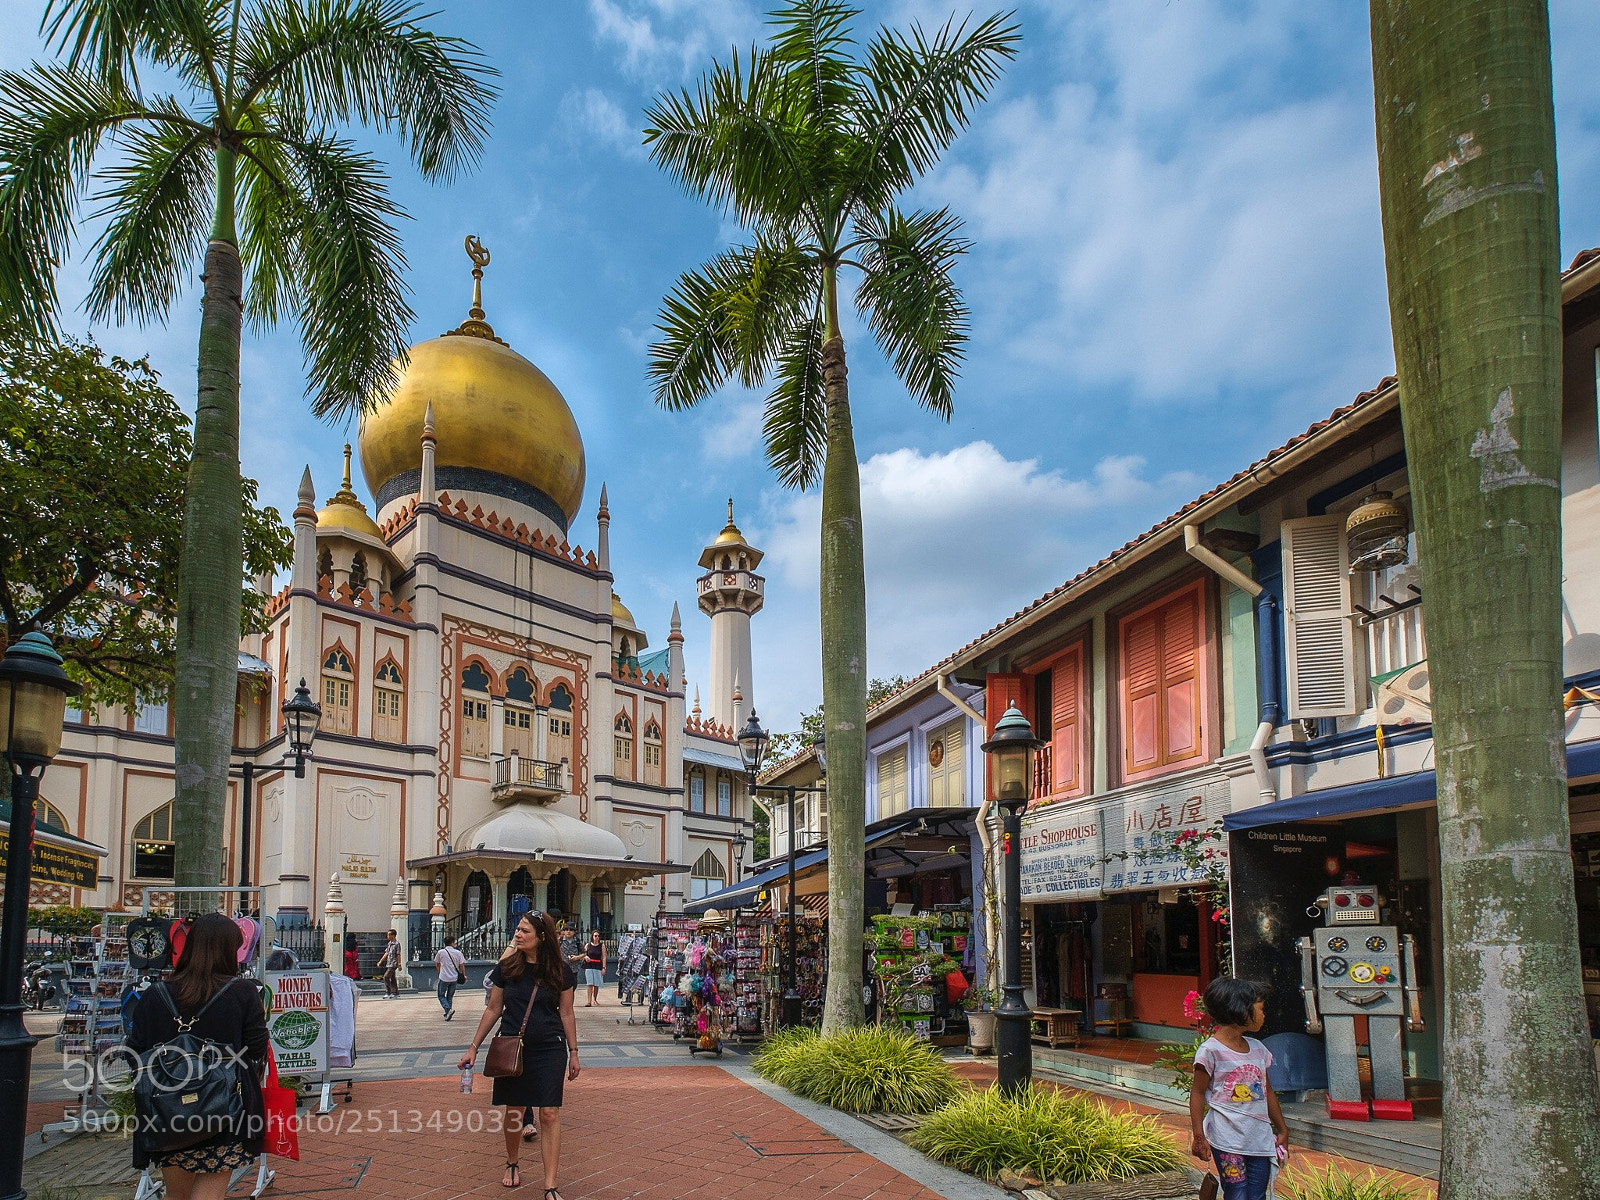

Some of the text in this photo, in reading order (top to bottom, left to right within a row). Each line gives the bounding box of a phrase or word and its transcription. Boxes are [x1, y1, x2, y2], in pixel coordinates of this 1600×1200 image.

[1126, 796, 1207, 833] 小店屋
[1248, 832, 1327, 843] Children Little Museum
[1273, 844, 1302, 853] Singapore
[1046, 878, 1100, 892] COLLECTIBLES
[278, 977, 312, 993] MONEY
[271, 992, 322, 1009] HANGERS
[278, 1052, 311, 1060] WAHAB
